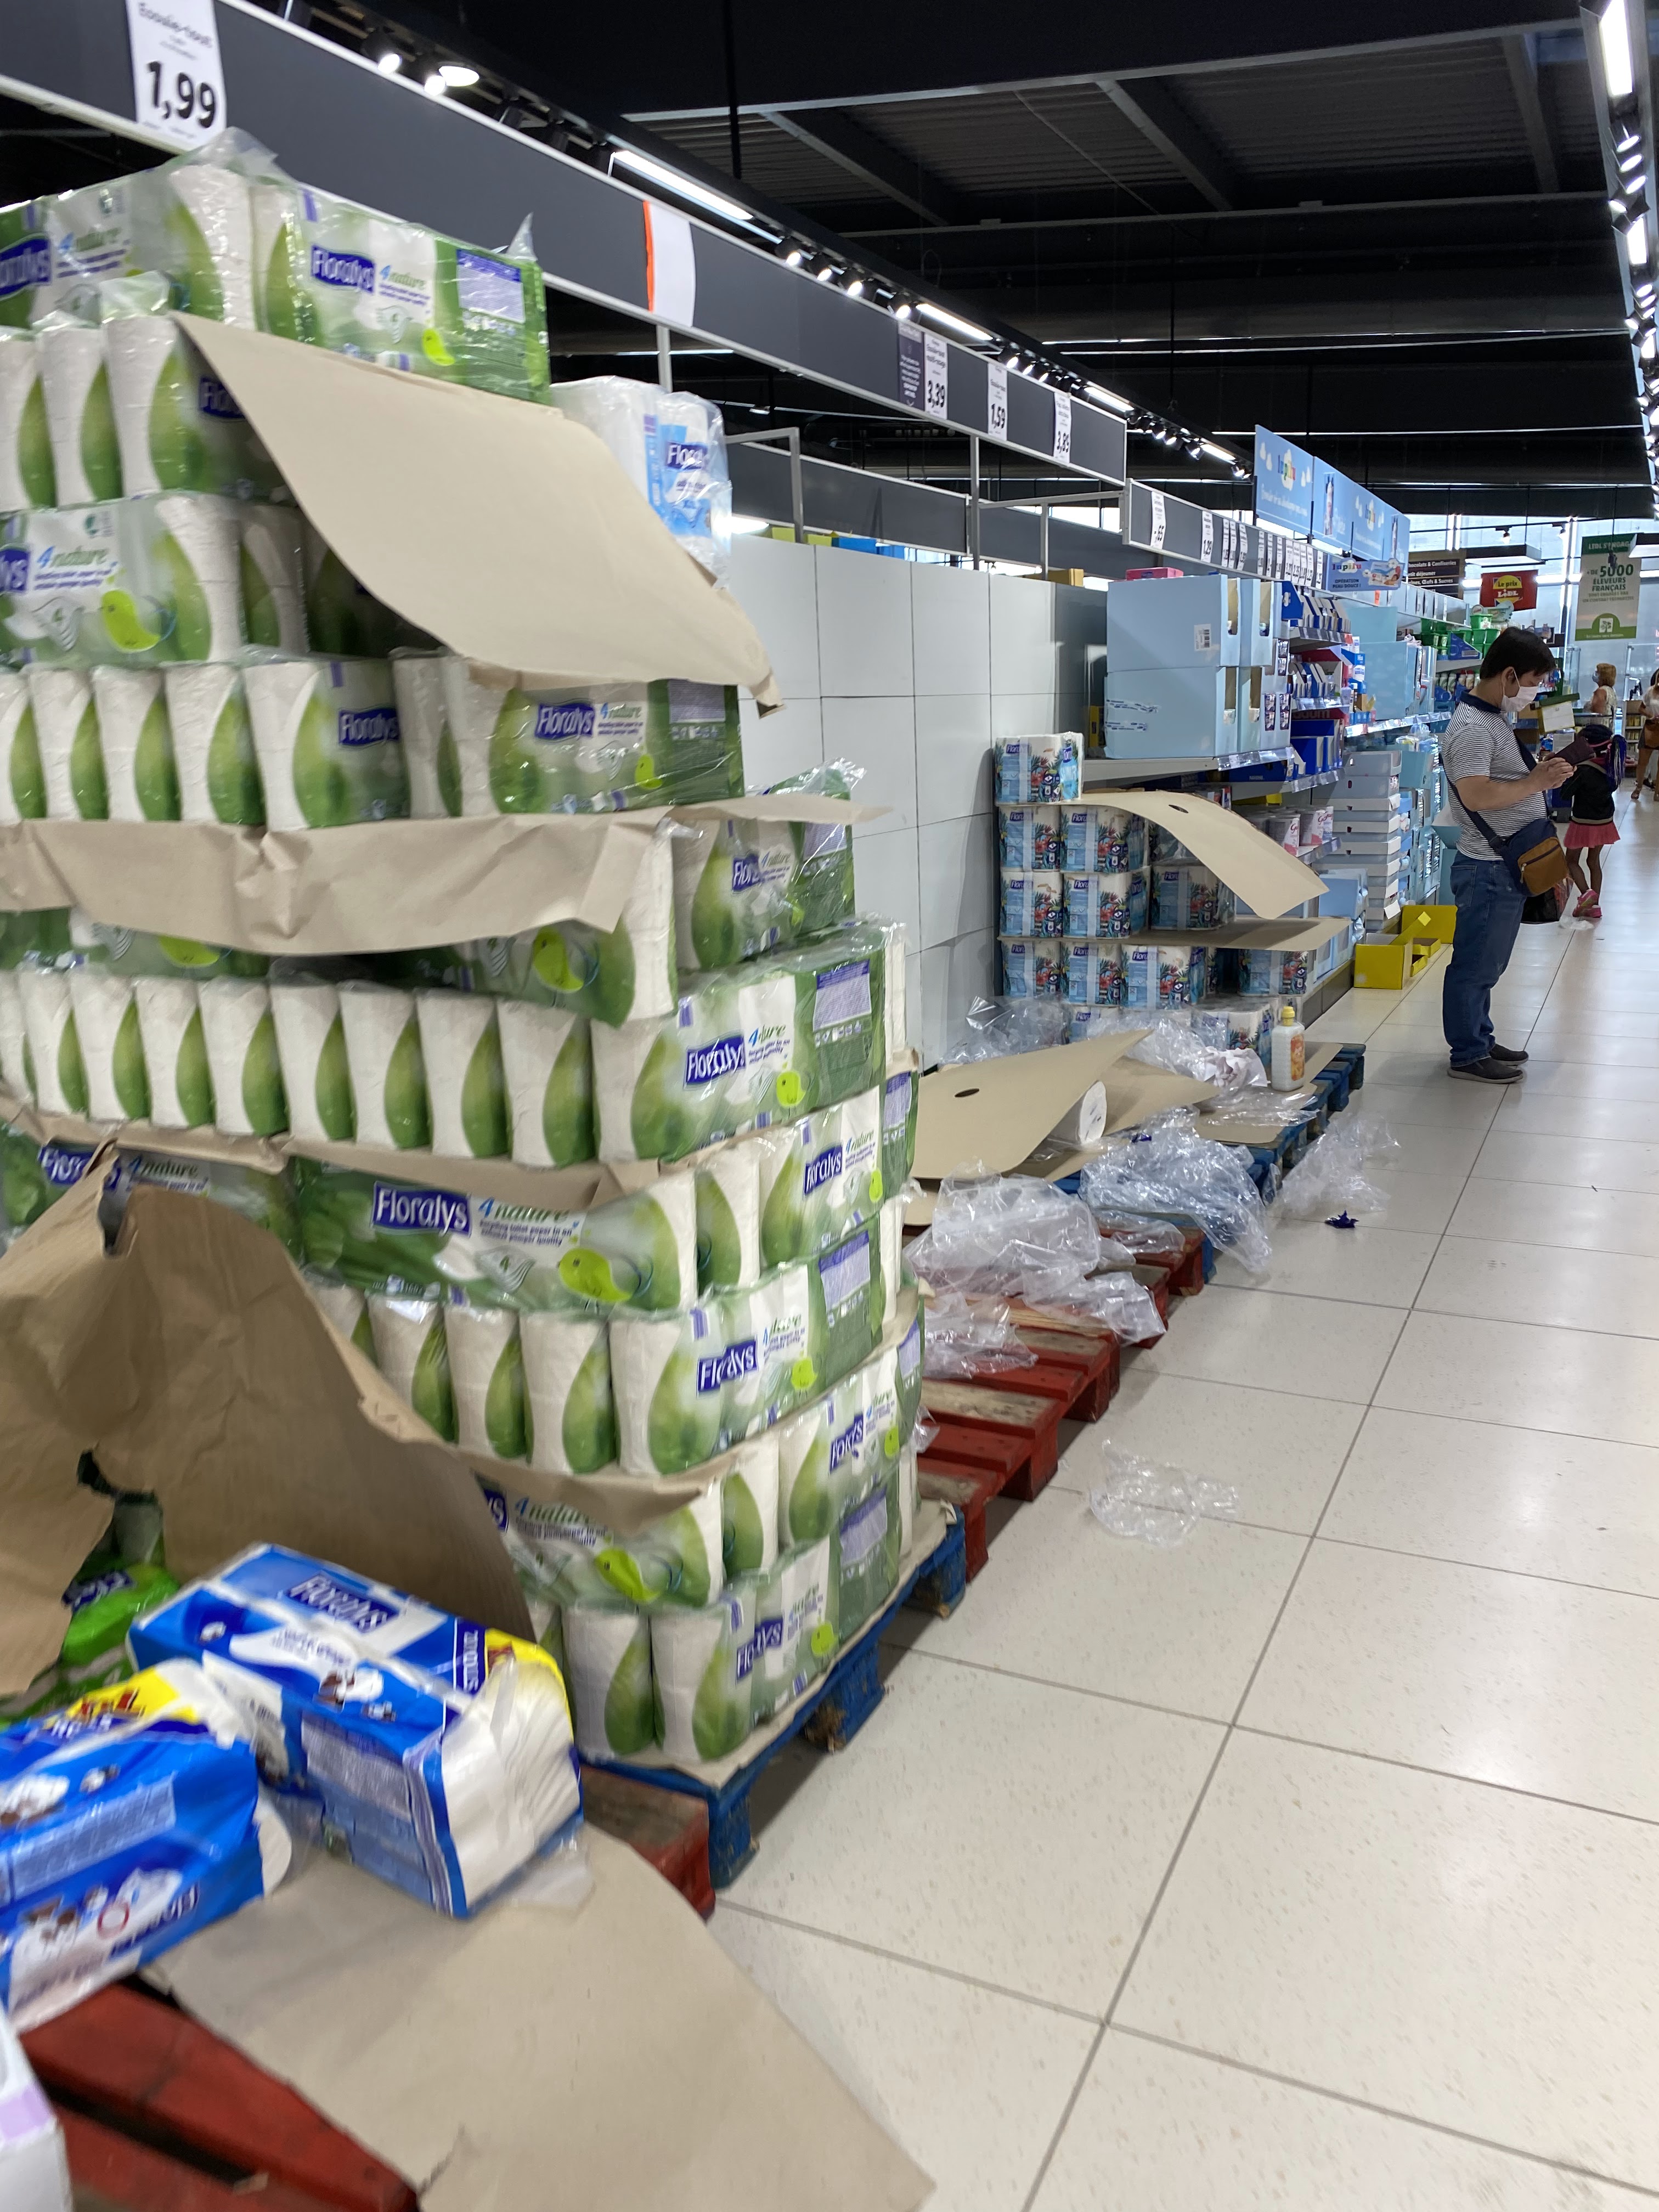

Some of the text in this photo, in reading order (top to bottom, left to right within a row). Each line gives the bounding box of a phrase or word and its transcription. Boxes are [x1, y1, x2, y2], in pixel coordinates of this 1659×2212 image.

[147, 61, 216, 128] 1,99
[1332, 563, 1362, 571] lupilu
[1600, 563, 1634, 577] 5000
[1592, 584, 1626, 593] FRANÇAIS
[537, 706, 595, 741] Floralys
[375, 1187, 468, 1235] Floralys
